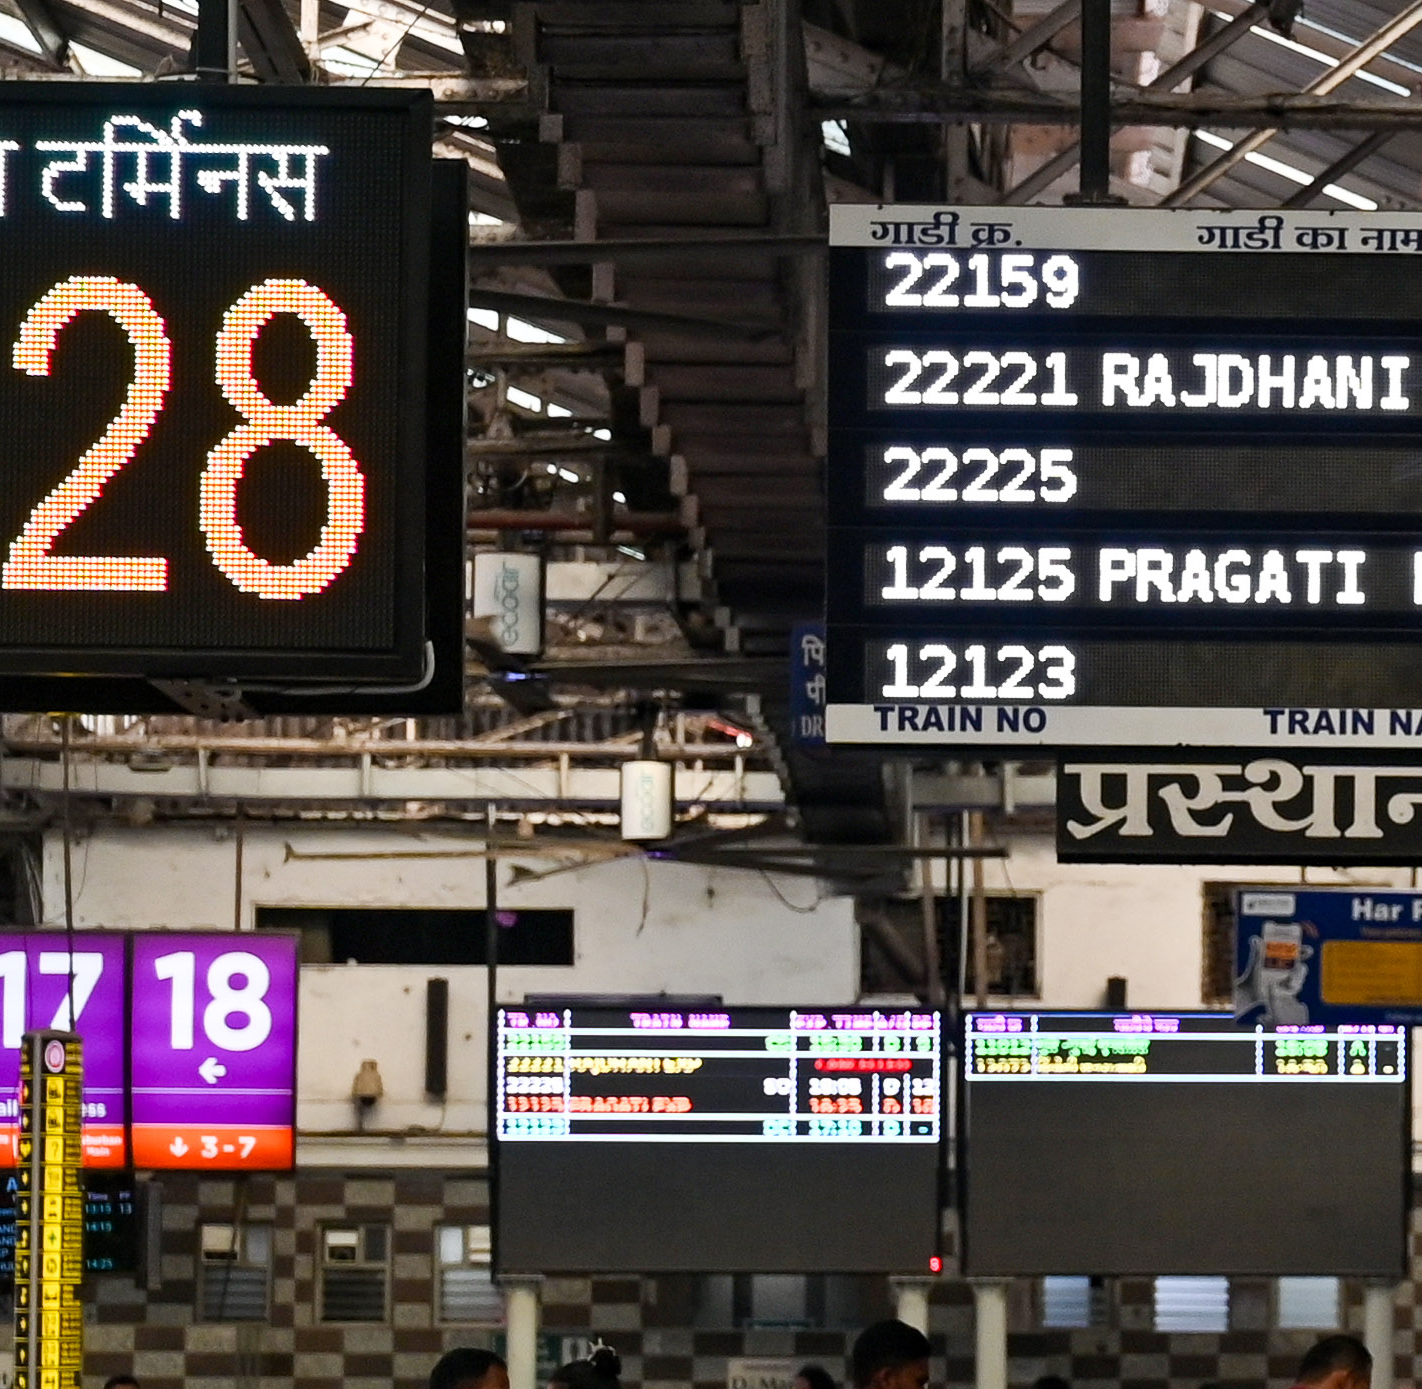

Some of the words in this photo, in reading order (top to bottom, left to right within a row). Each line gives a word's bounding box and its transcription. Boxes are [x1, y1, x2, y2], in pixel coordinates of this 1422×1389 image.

[36, 110, 328, 221] टर्मिनस
[870, 214, 961, 246] गाडी
[1196, 215, 1285, 249] गाडी
[1294, 226, 1349, 251] का
[886, 253, 1078, 308] 22159
[885, 351, 1077, 405] 22221
[1103, 353, 1409, 409] RAJDHANI
[884, 447, 1076, 502] 22225
[882, 546, 1074, 601] 12125
[1100, 549, 1365, 604] PRAGATI
[883, 645, 1075, 698] 12123
[874, 706, 984, 733] TRAIN
[995, 708, 1047, 734] NO
[1263, 709, 1376, 736] TRAIN
[1351, 897, 1403, 922] Har
[155, 952, 270, 1052] 18
[202, 1136, 256, 1159] 3-7
